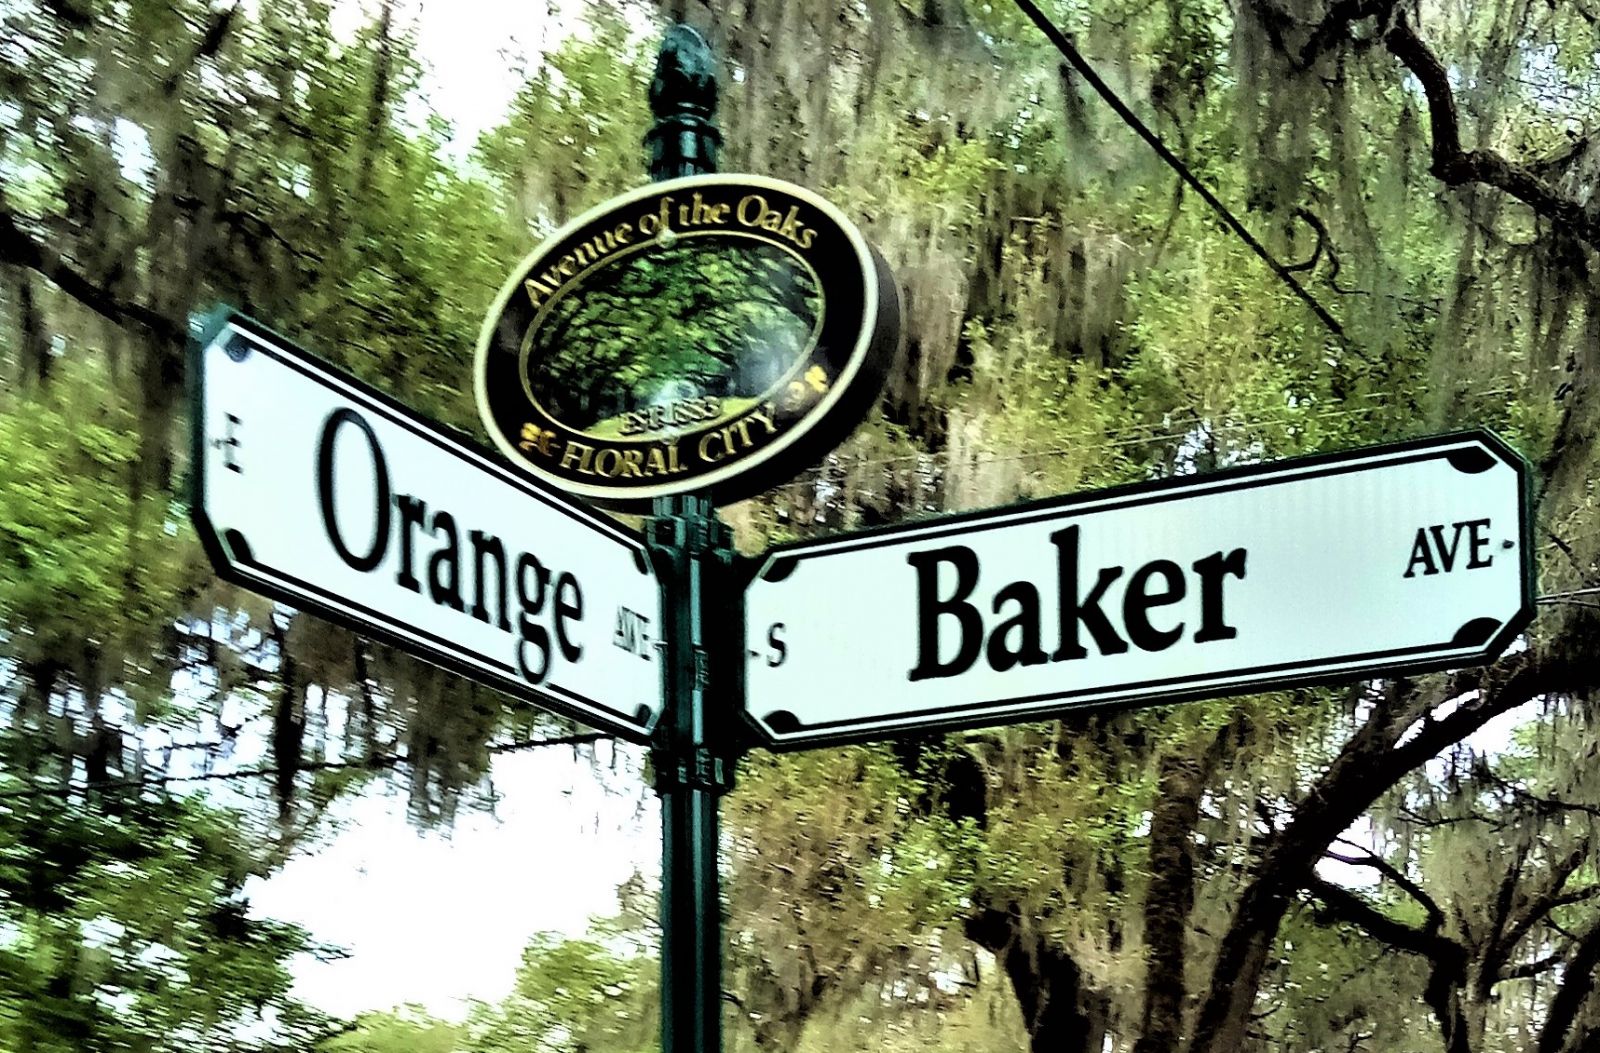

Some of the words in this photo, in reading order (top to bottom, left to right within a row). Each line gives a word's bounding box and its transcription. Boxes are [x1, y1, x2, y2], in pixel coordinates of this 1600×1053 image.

[523, 222, 634, 309] Avenue
[638, 197, 674, 236] of
[678, 192, 731, 227] the
[737, 194, 818, 250] Oaks
[560, 440, 689, 479] FLORAL
[698, 402, 779, 463] CITY
[223, 410, 244, 474] E
[318, 406, 584, 685] Orange
[766, 623, 788, 667] S
[906, 525, 1246, 682] Baker
[1403, 519, 1493, 579] AVE
